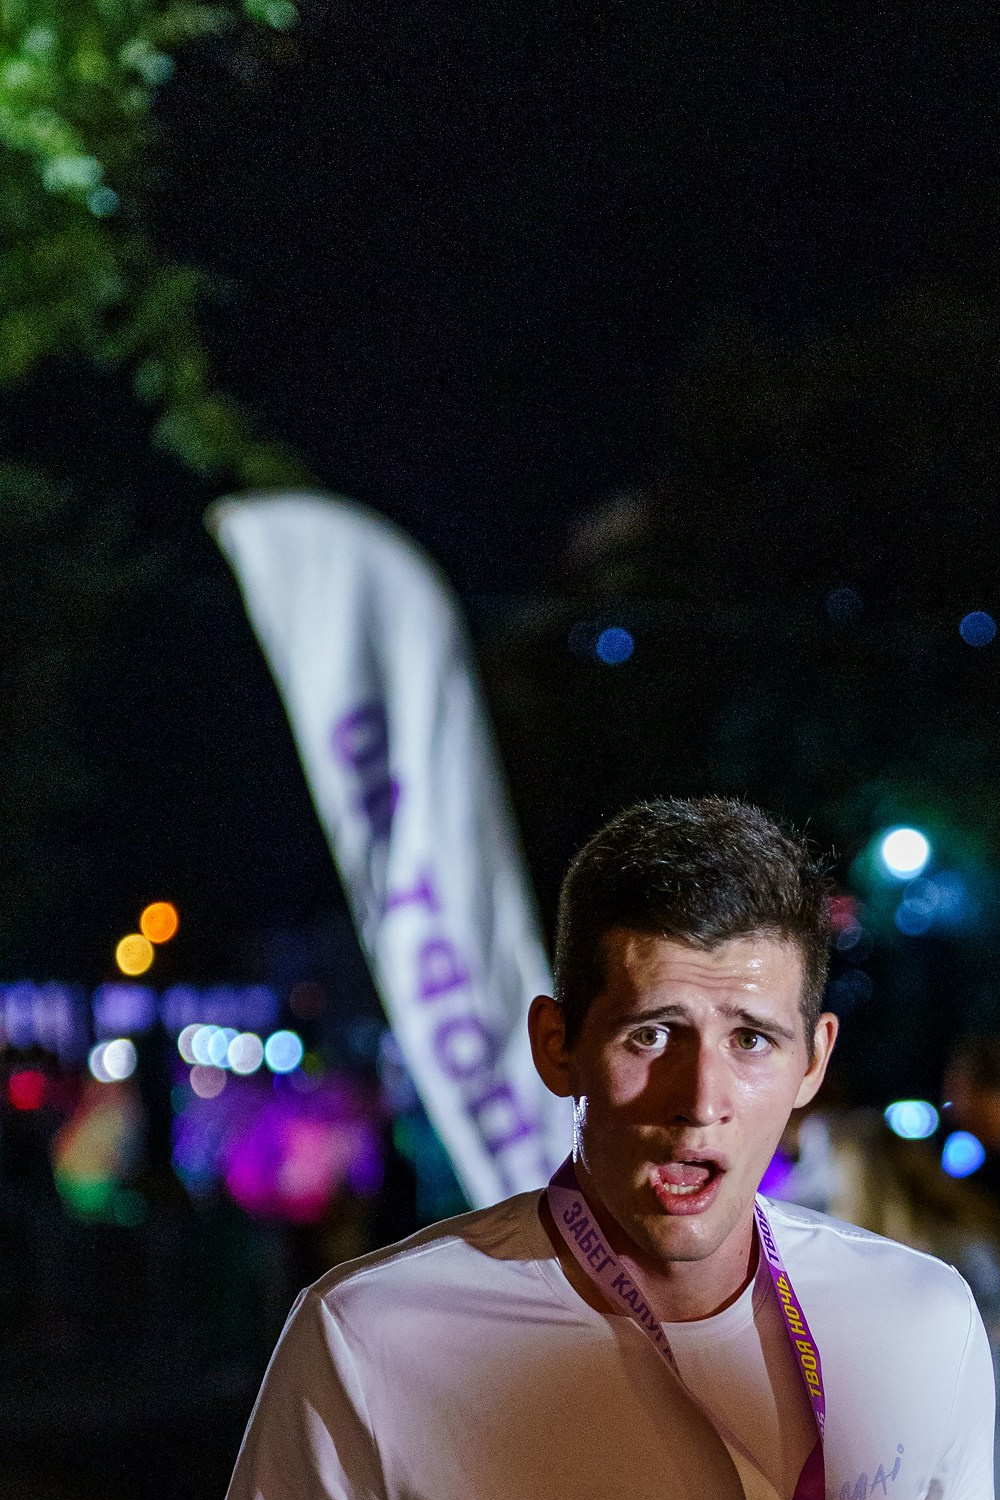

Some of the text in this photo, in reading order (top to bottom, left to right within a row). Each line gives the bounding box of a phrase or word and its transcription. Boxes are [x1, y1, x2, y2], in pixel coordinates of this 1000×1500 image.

[383, 857, 555, 1197] ПОРТ
[562, 1201, 617, 1274] ЗАБЕГ
[755, 1206, 780, 1262] ТВОЯ
[795, 1339, 822, 1398] ТВОЯ
